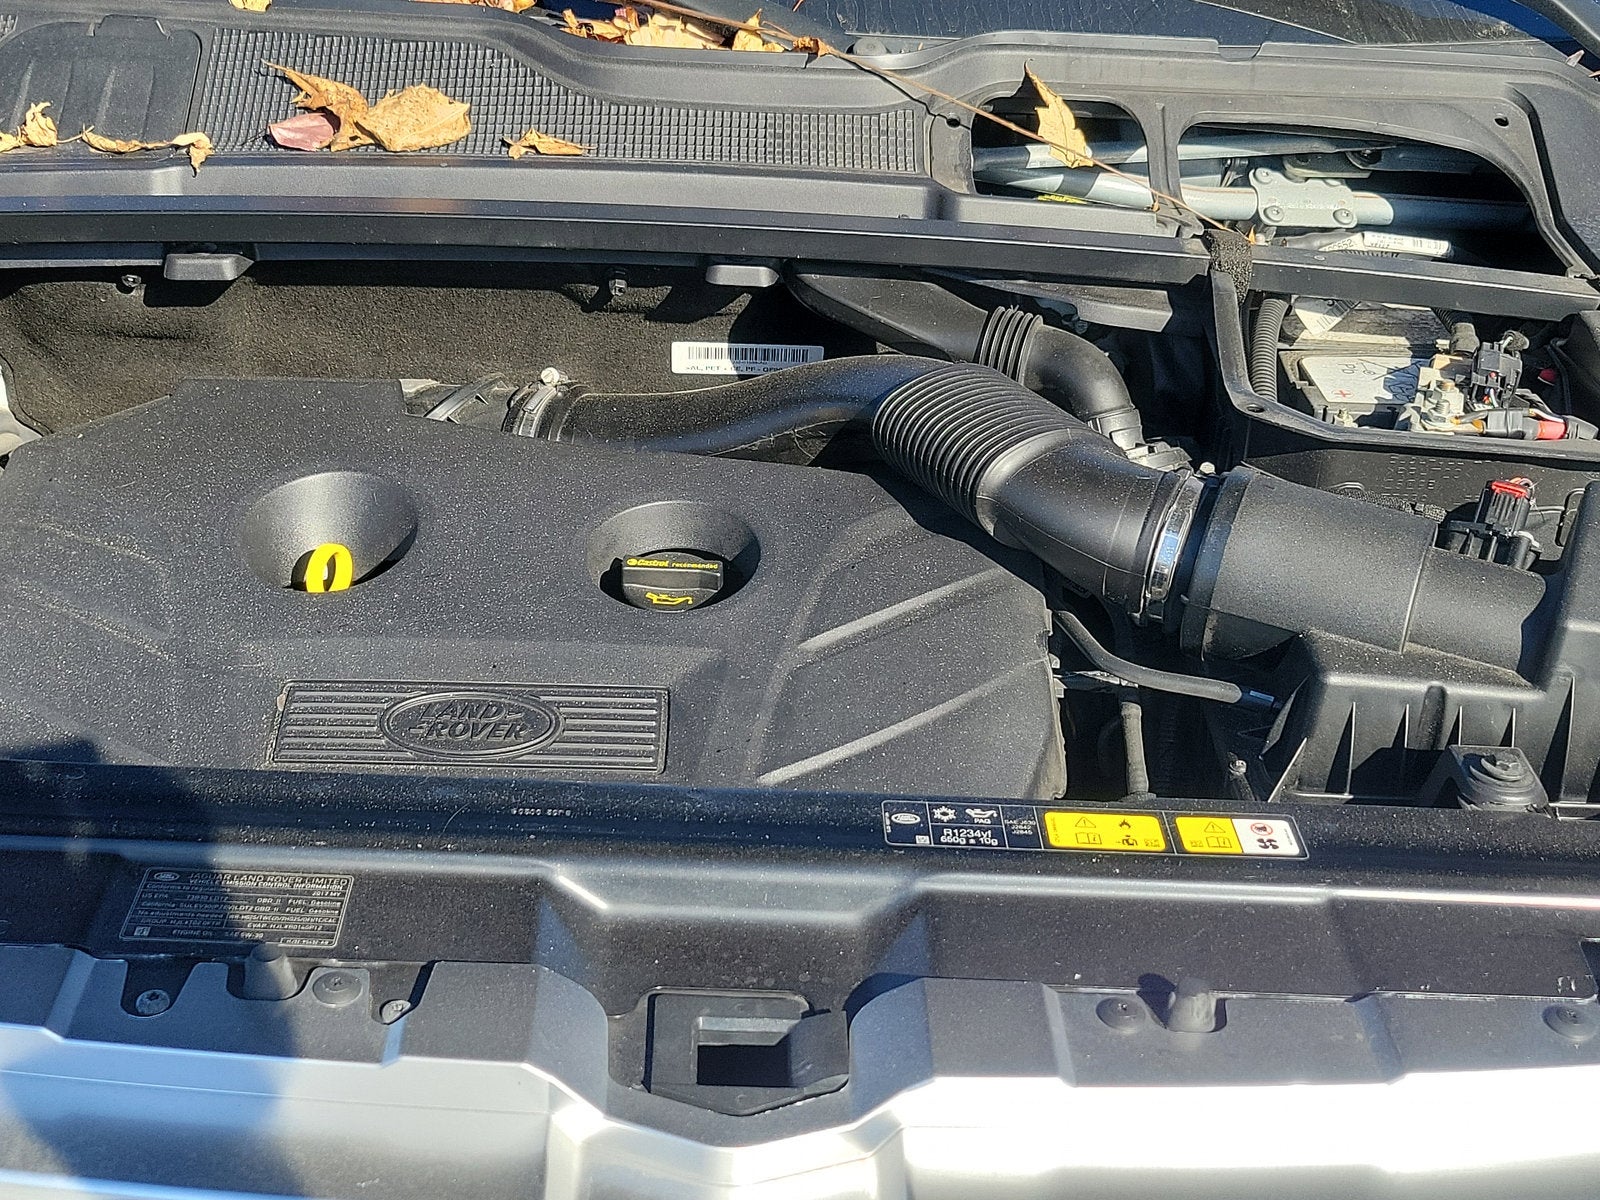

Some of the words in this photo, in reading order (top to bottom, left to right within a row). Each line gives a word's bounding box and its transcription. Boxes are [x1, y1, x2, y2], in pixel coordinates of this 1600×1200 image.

[636, 559, 669, 568] Castrol
[420, 703, 504, 722] LAND
[425, 721, 528, 741] ROVER
[943, 828, 992, 839] R1234yf
[979, 837, 998, 846] 10g
[188, 872, 232, 881] JAGUAR
[233, 874, 264, 882] LAND
[266, 875, 302, 883] ROVER
[304, 877, 348, 886] LIMITED
[221, 880, 256, 888] EMISSION
[256, 881, 291, 889] CONTROL
[293, 882, 344, 891] INFORMATION
